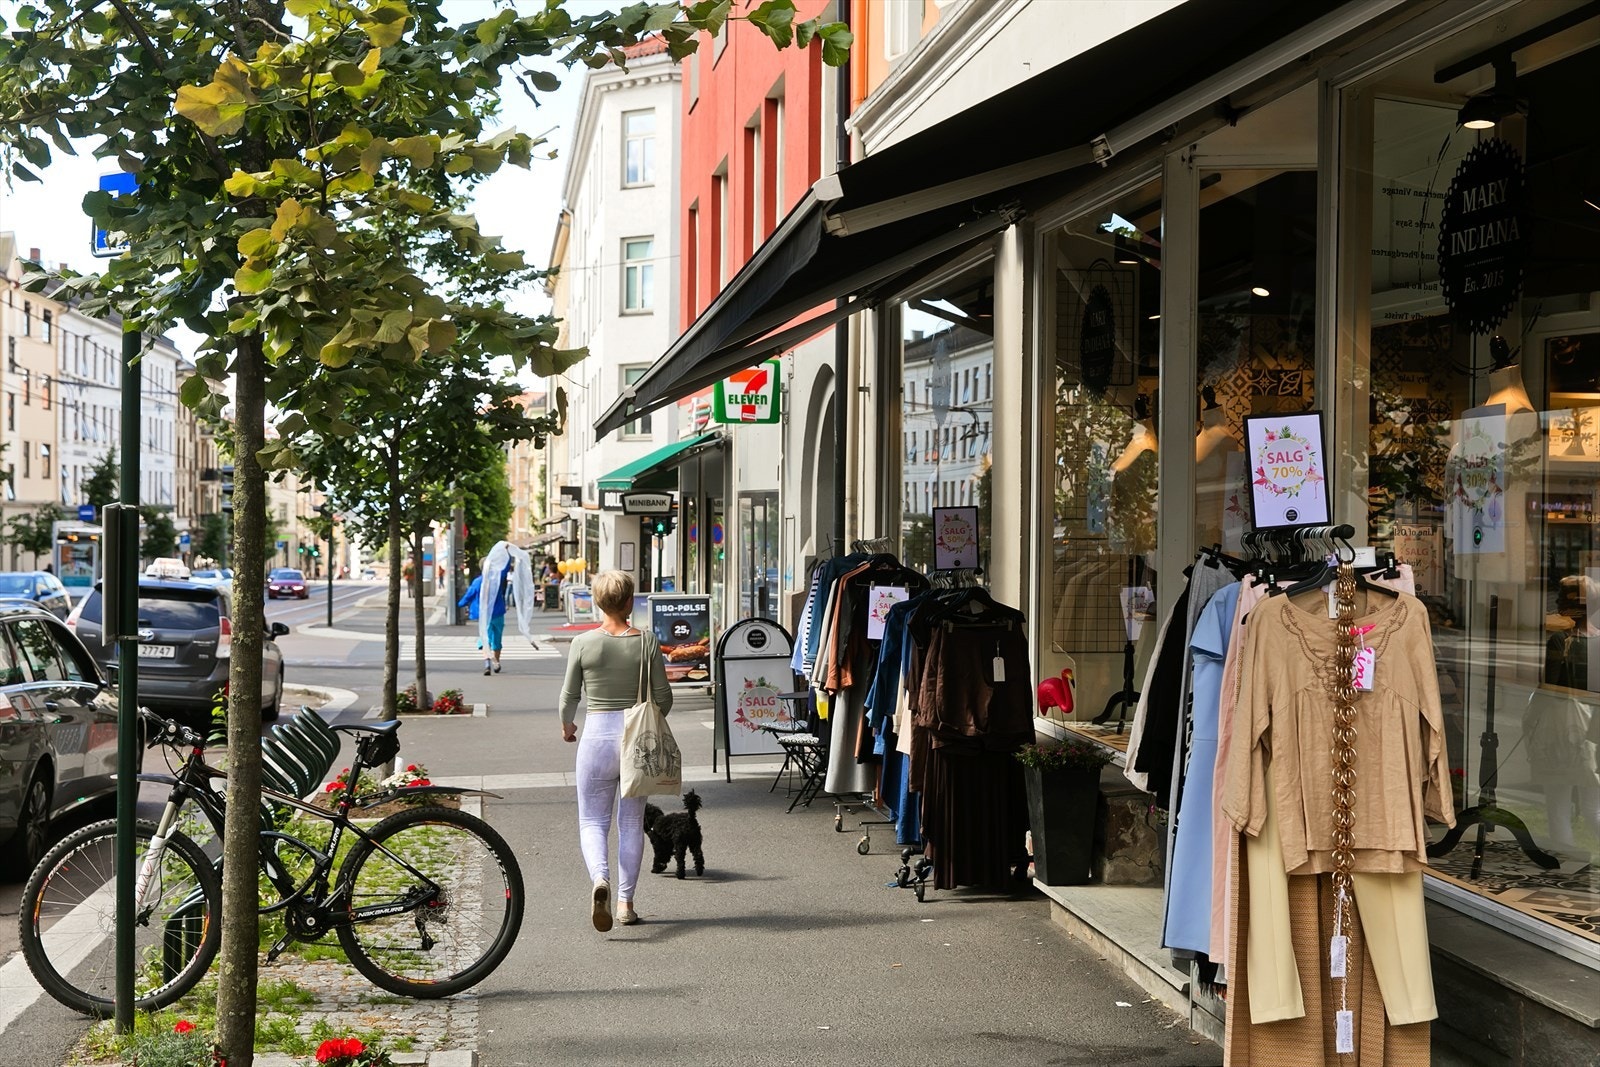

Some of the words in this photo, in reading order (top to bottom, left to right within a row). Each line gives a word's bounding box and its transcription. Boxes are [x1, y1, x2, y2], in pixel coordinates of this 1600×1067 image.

[1462, 178, 1509, 214] MARY
[1450, 216, 1521, 256] INDIANA
[1482, 270, 1505, 289] 2015
[729, 370, 768, 421] 7
[1267, 450, 1303, 464] SALG
[1272, 466, 1302, 479] 70%
[945, 527, 965, 535] SALG
[1406, 548, 1428, 557] SALG
[655, 604, 706, 612] BBQ-PØLSE
[142, 646, 171, 656] 27747
[745, 696, 776, 707] SALG
[749, 708, 775, 719] 30%
